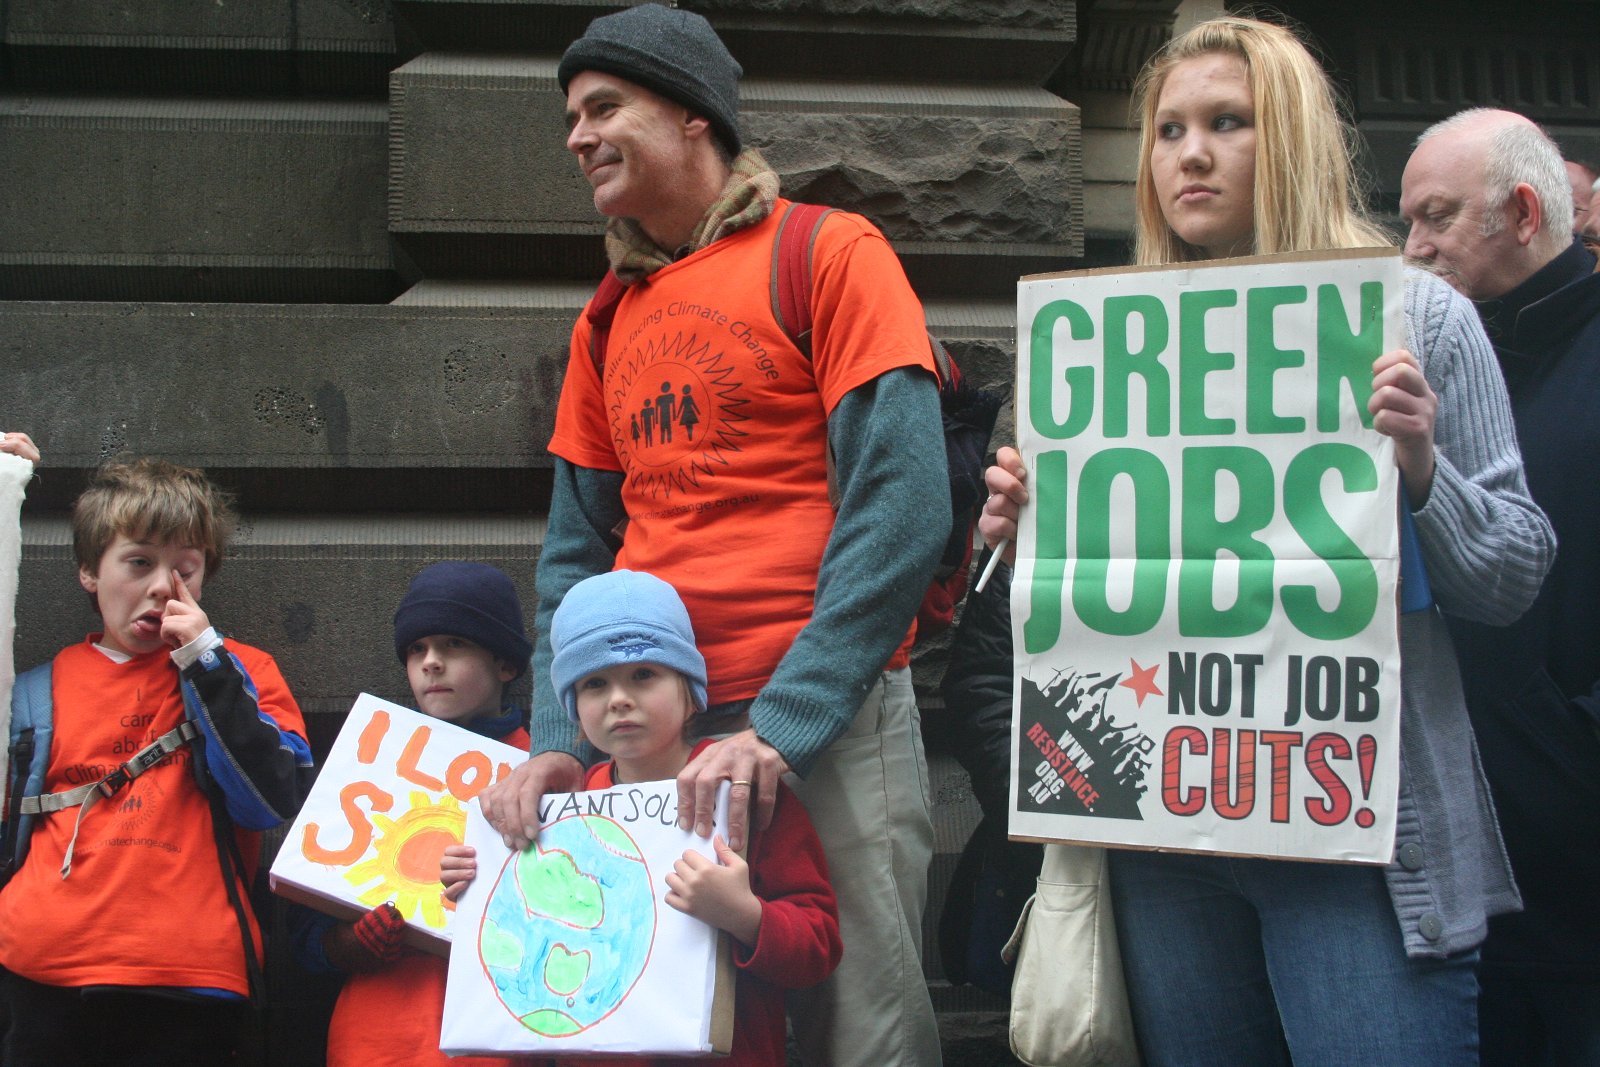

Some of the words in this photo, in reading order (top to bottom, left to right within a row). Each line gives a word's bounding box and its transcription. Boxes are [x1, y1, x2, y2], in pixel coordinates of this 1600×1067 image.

[629, 308, 662, 344] facing
[667, 300, 728, 326] Climate
[729, 321, 780, 381] Change
[1029, 281, 1383, 440] GREEN
[1023, 442, 1378, 654] JOBS
[136, 688, 141, 701] I
[1168, 651, 1264, 718] NOT
[1284, 655, 1380, 726] JOB
[64, 763, 120, 785] Clima
[357, 710, 390, 764] I
[396, 725, 513, 802] LO
[1025, 722, 1100, 812] RESISTANCE.
[1028, 780, 1052, 805] AU
[1035, 760, 1065, 800] ORG.
[1057, 729, 1095, 778] WWW.
[1161, 725, 1378, 829] CUTS!
